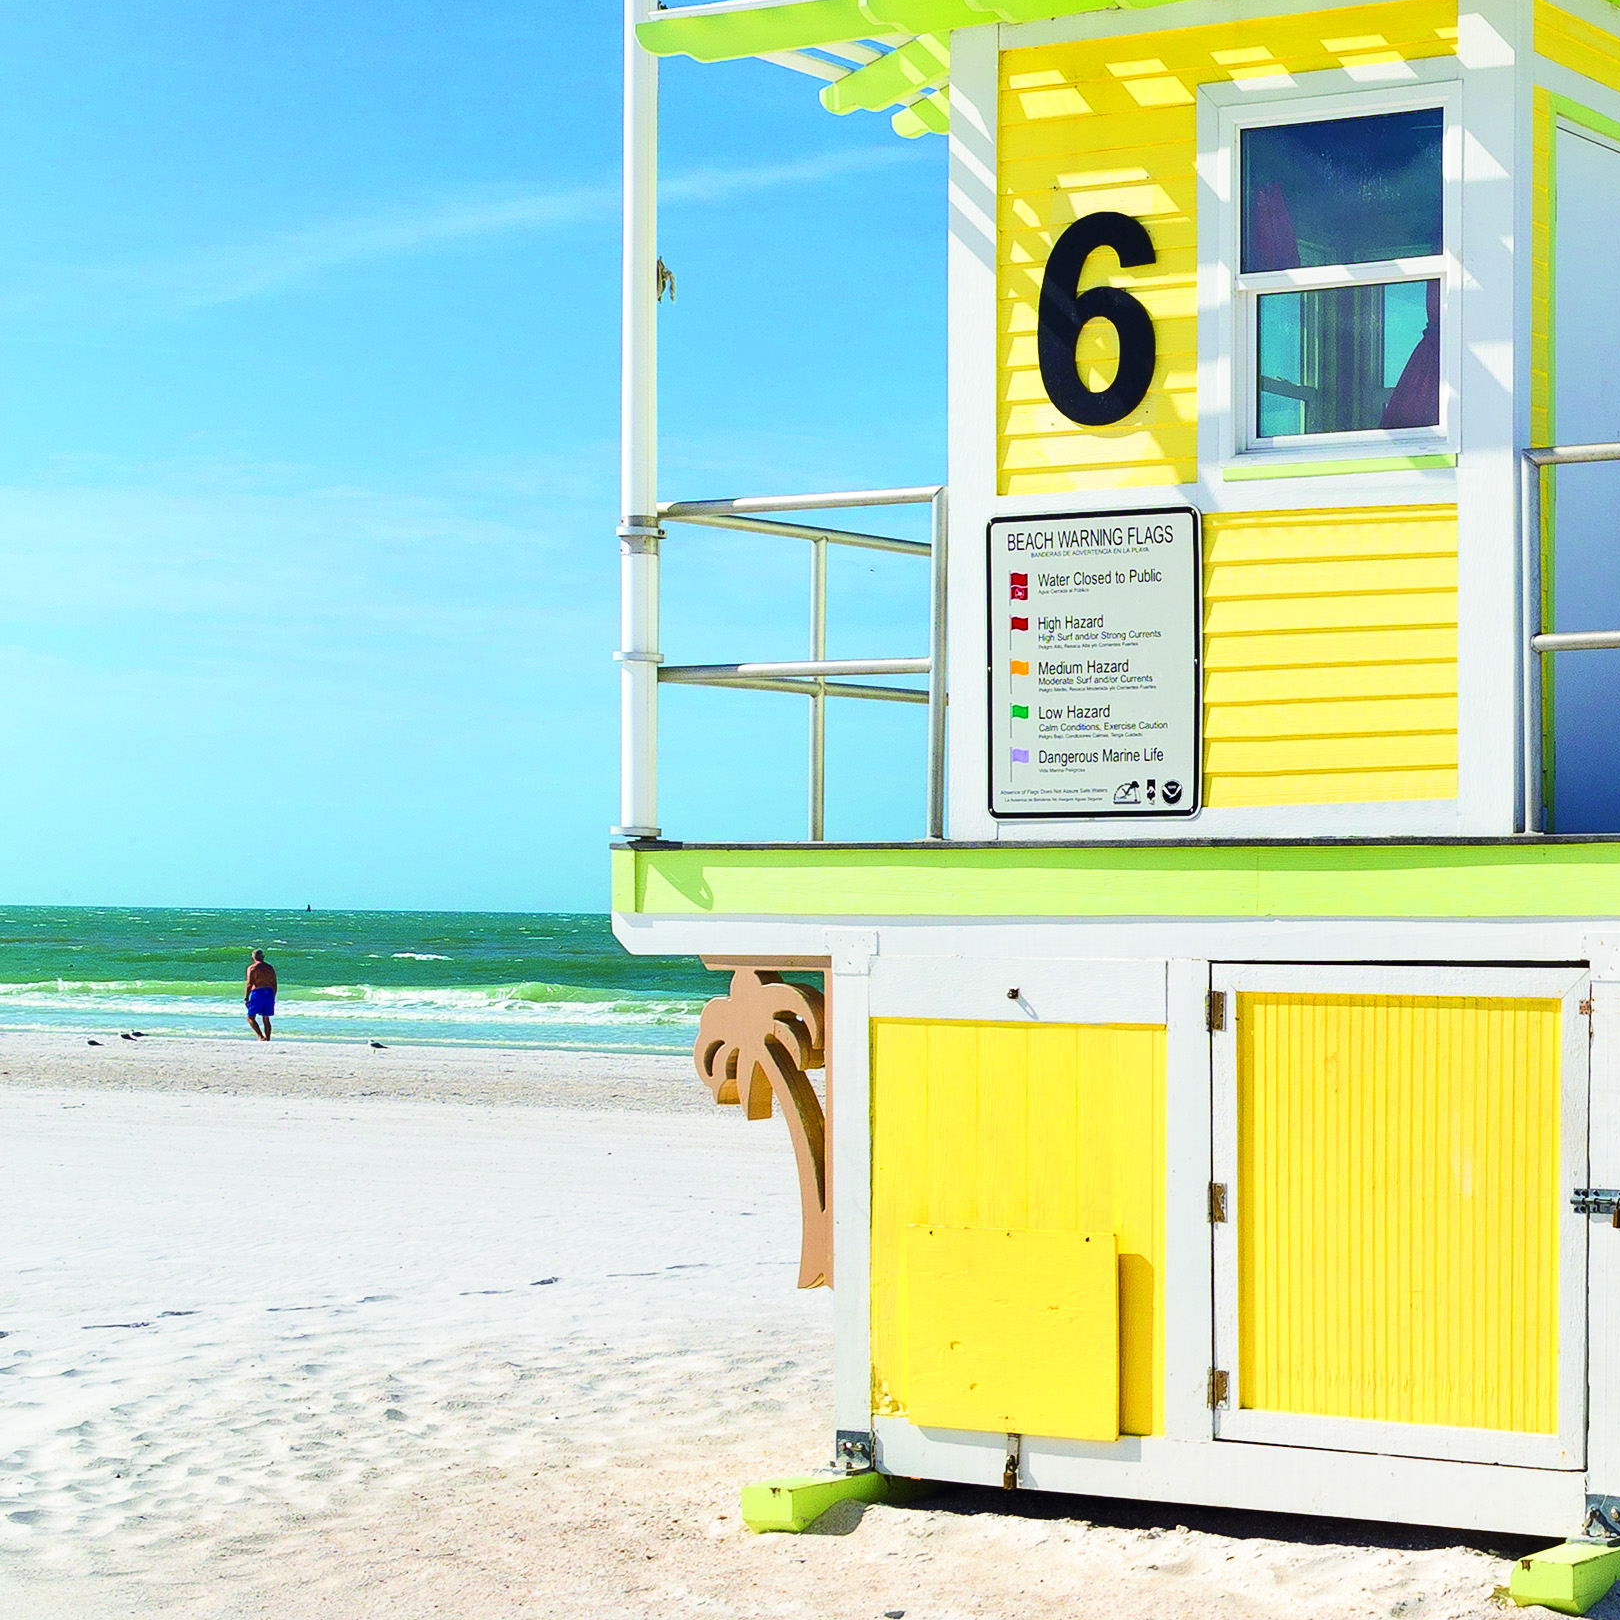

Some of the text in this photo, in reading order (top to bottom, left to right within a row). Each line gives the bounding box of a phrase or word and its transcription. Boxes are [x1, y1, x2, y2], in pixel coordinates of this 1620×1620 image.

[1037, 211, 1157, 426] 6
[1008, 525, 1173, 551] BEACH WARNING FLAGS
[1038, 569, 1162, 587] Water Closed to Public
[1038, 615, 1103, 633] High Hazard
[1038, 634, 1055, 643] High
[1057, 632, 1073, 641] Surf
[1075, 632, 1098, 640] and/or
[1101, 631, 1126, 641] Strong
[1039, 660, 1129, 675] Medium Hazard
[1039, 675, 1152, 685] Moderate Surf and/or Currents
[1039, 704, 1110, 719] Low Hazard
[1039, 721, 1168, 732] Calm Conditions, Exercise Caution
[1039, 747, 1163, 766] Dangerous Marine Life
